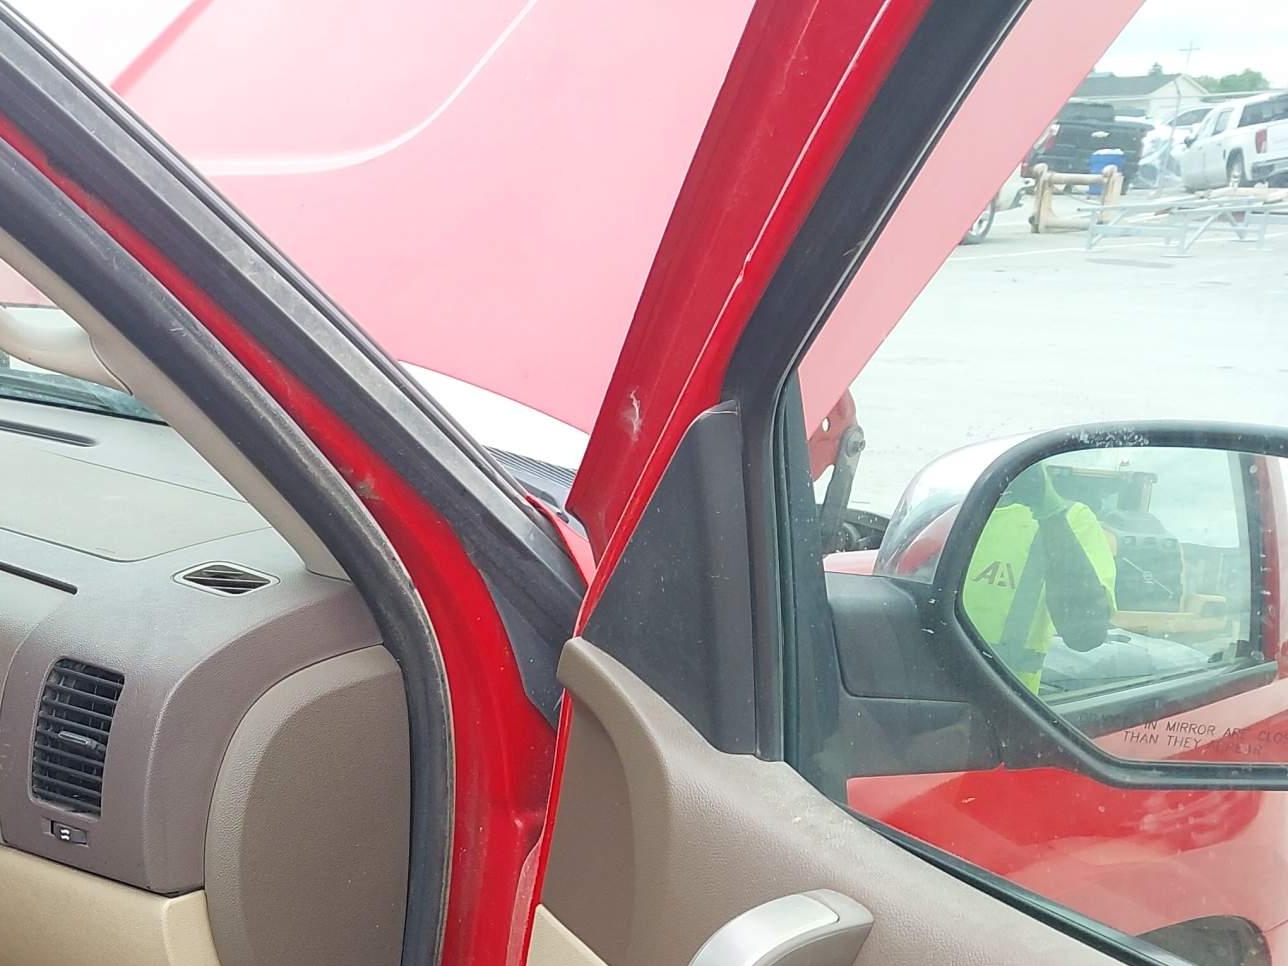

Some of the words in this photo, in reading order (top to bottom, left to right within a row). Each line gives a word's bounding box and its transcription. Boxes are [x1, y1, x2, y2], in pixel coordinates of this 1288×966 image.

[1166, 720, 1216, 737] MIRROR
[1223, 727, 1244, 738] ARE
[1122, 730, 1159, 744] THAN
[1167, 735, 1202, 751] THEY
